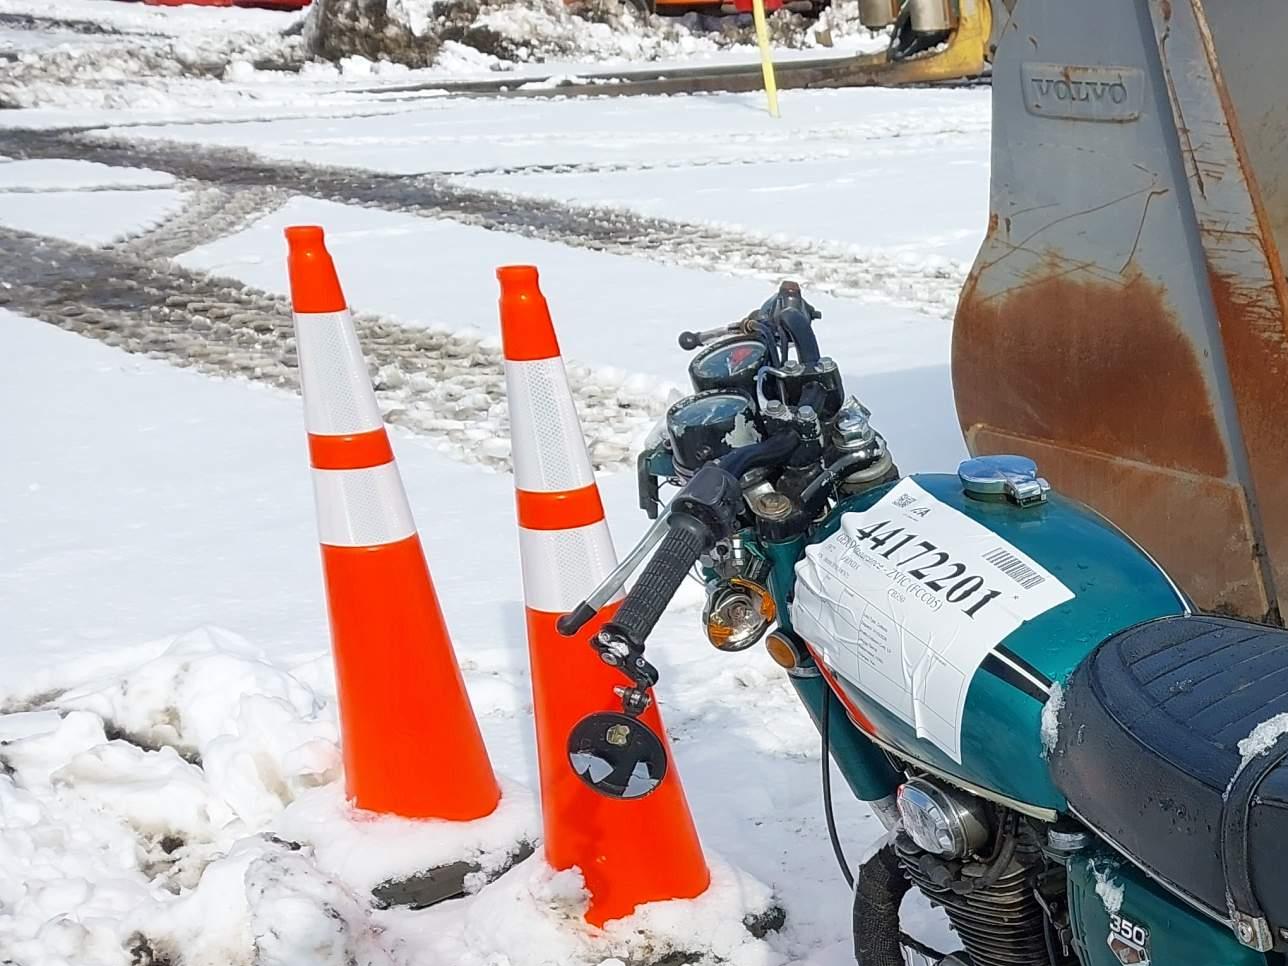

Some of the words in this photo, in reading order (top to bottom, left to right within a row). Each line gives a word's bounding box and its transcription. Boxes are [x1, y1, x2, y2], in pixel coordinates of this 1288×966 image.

[1031, 78, 1127, 104] VOLVO
[856, 520, 1002, 620] 44172201
[1109, 913, 1146, 946] 350
